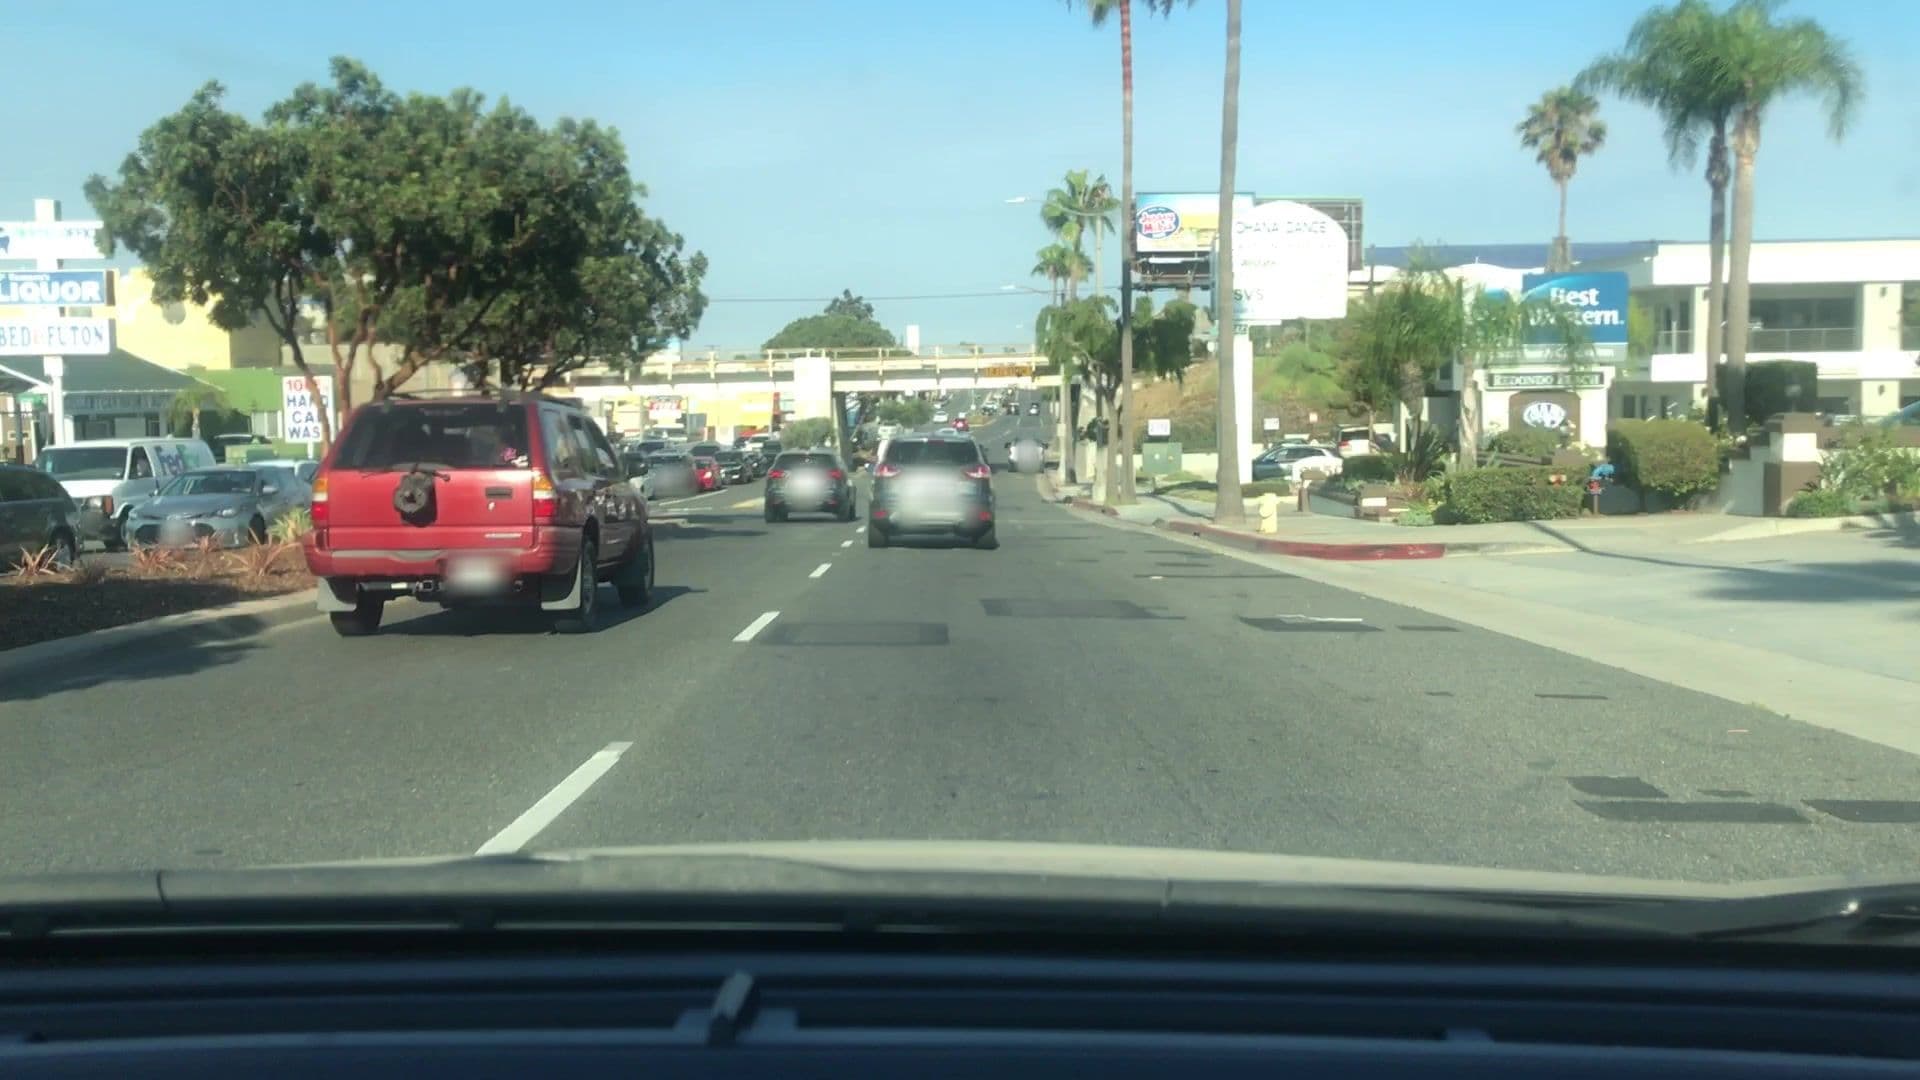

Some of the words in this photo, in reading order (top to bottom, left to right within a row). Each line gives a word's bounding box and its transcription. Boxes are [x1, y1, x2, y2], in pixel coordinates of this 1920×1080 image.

[1286, 221, 1326, 233] DANCE
[1549, 287, 1599, 306] Best
[47, 325, 104, 346] FUTON
